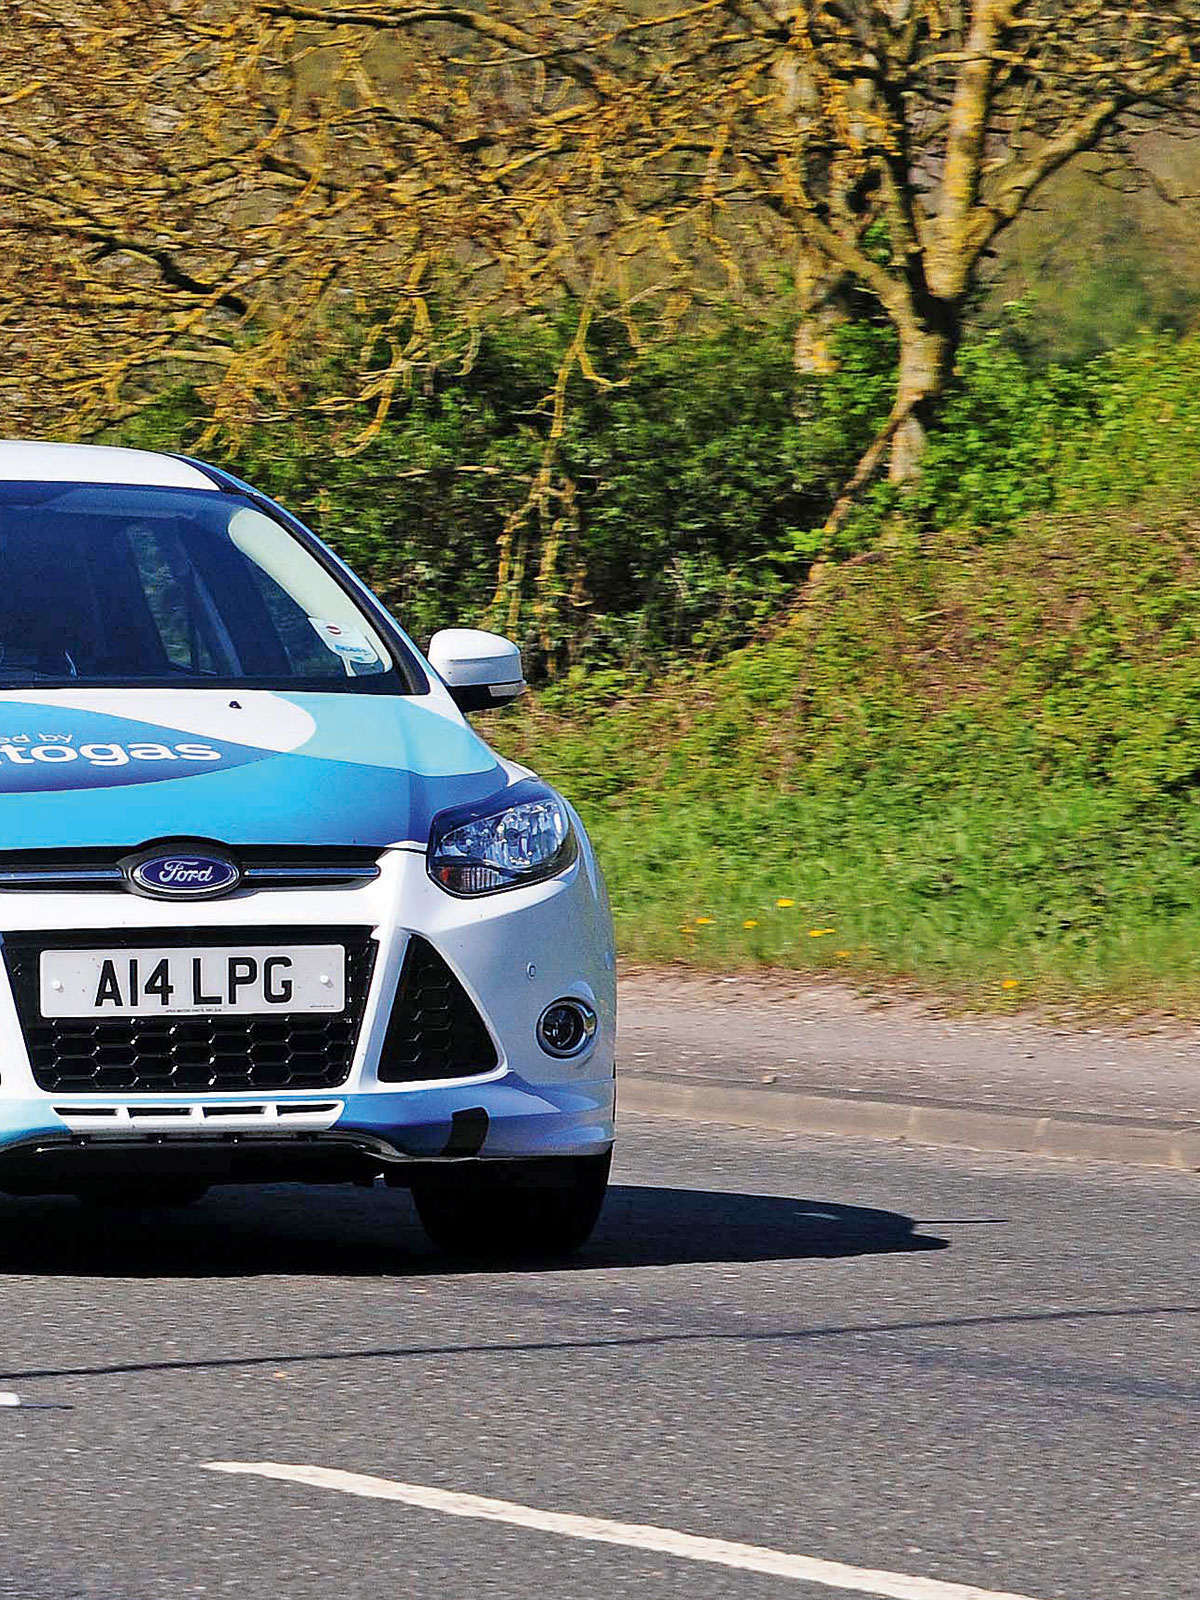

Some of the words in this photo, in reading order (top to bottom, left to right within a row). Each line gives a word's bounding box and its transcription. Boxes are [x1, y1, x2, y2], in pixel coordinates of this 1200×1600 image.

[38, 732, 73, 744] by
[159, 859, 213, 882] Ford
[94, 958, 174, 1007] A14
[192, 956, 293, 1005] LPG
